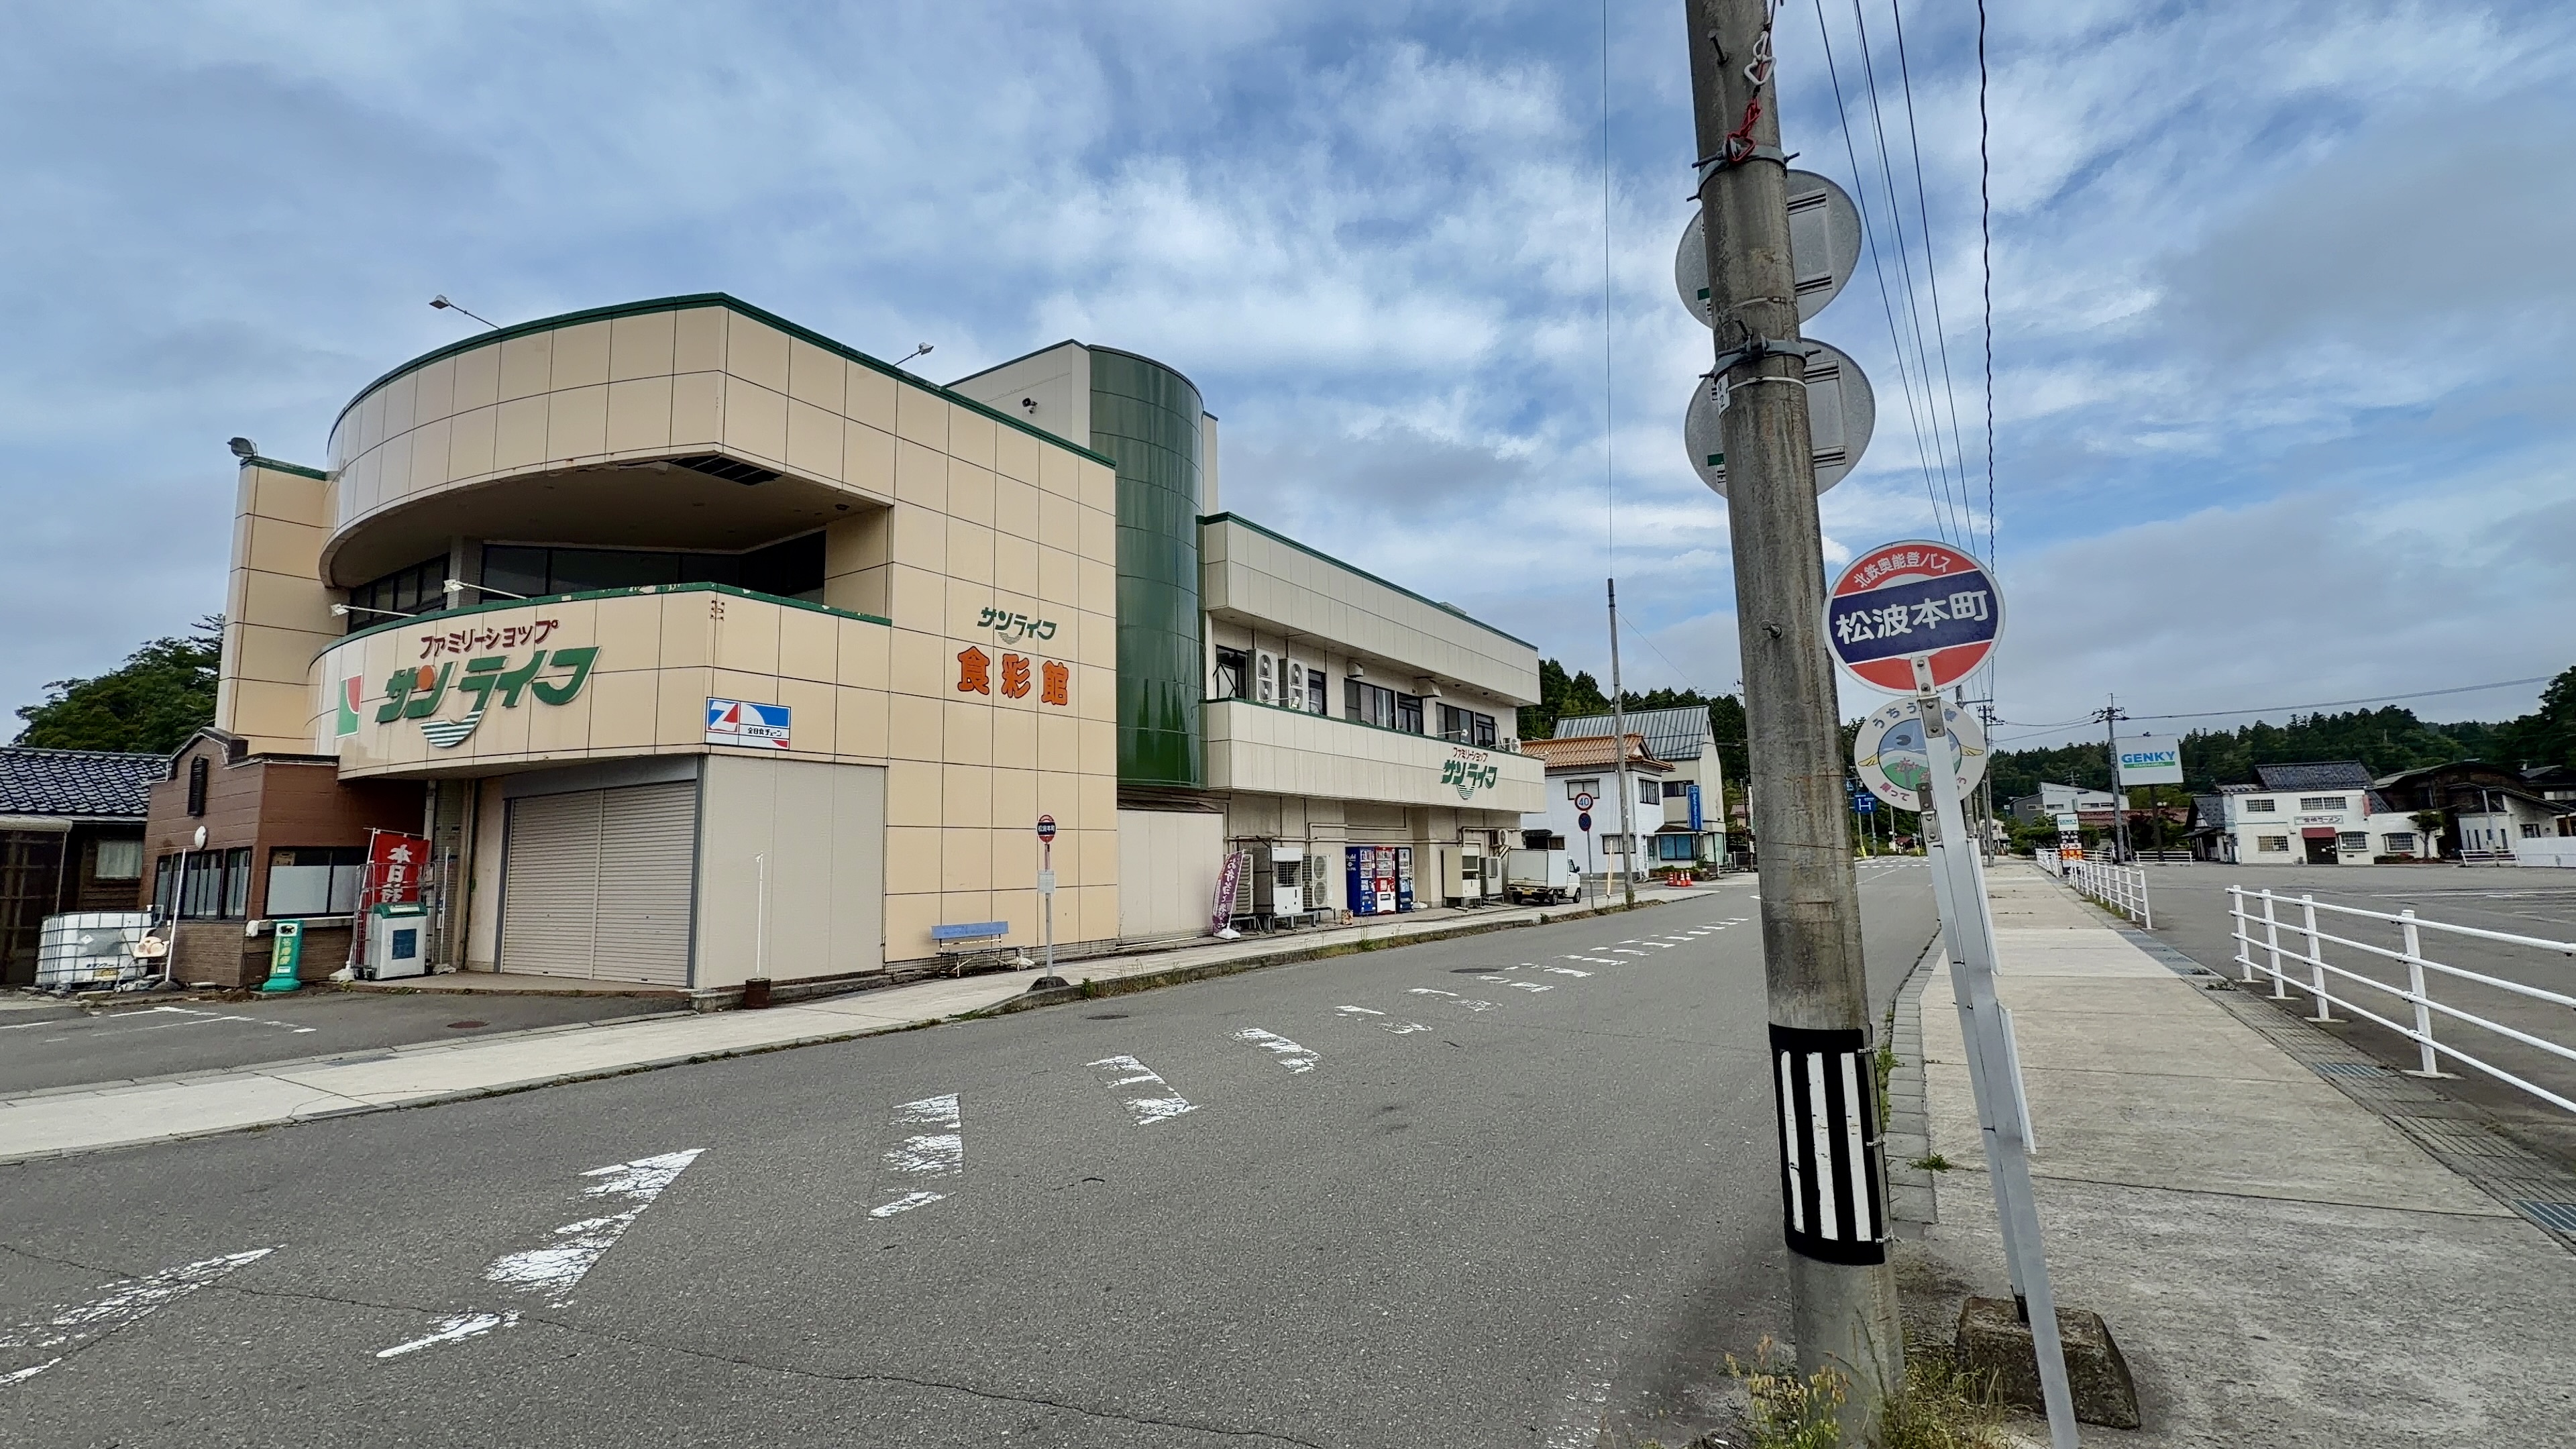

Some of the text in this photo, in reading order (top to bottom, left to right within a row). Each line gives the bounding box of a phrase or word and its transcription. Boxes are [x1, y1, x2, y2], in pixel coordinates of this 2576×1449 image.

[1854, 551, 1951, 588] 北鉄奥能登バス
[977, 606, 1057, 641] サンライフ
[1835, 590, 1988, 645] 松波本町
[419, 619, 559, 659] ファミリーショップ
[375, 646, 602, 728] サンライフ
[957, 646, 1069, 706] 食彩館
[747, 727, 782, 737] 全日食チェーン
[1453, 747, 1488, 761] ファミリーショップ
[2121, 751, 2175, 763] GENKY
[1440, 759, 1498, 789] サンライフ
[1578, 798, 1589, 806] 40
